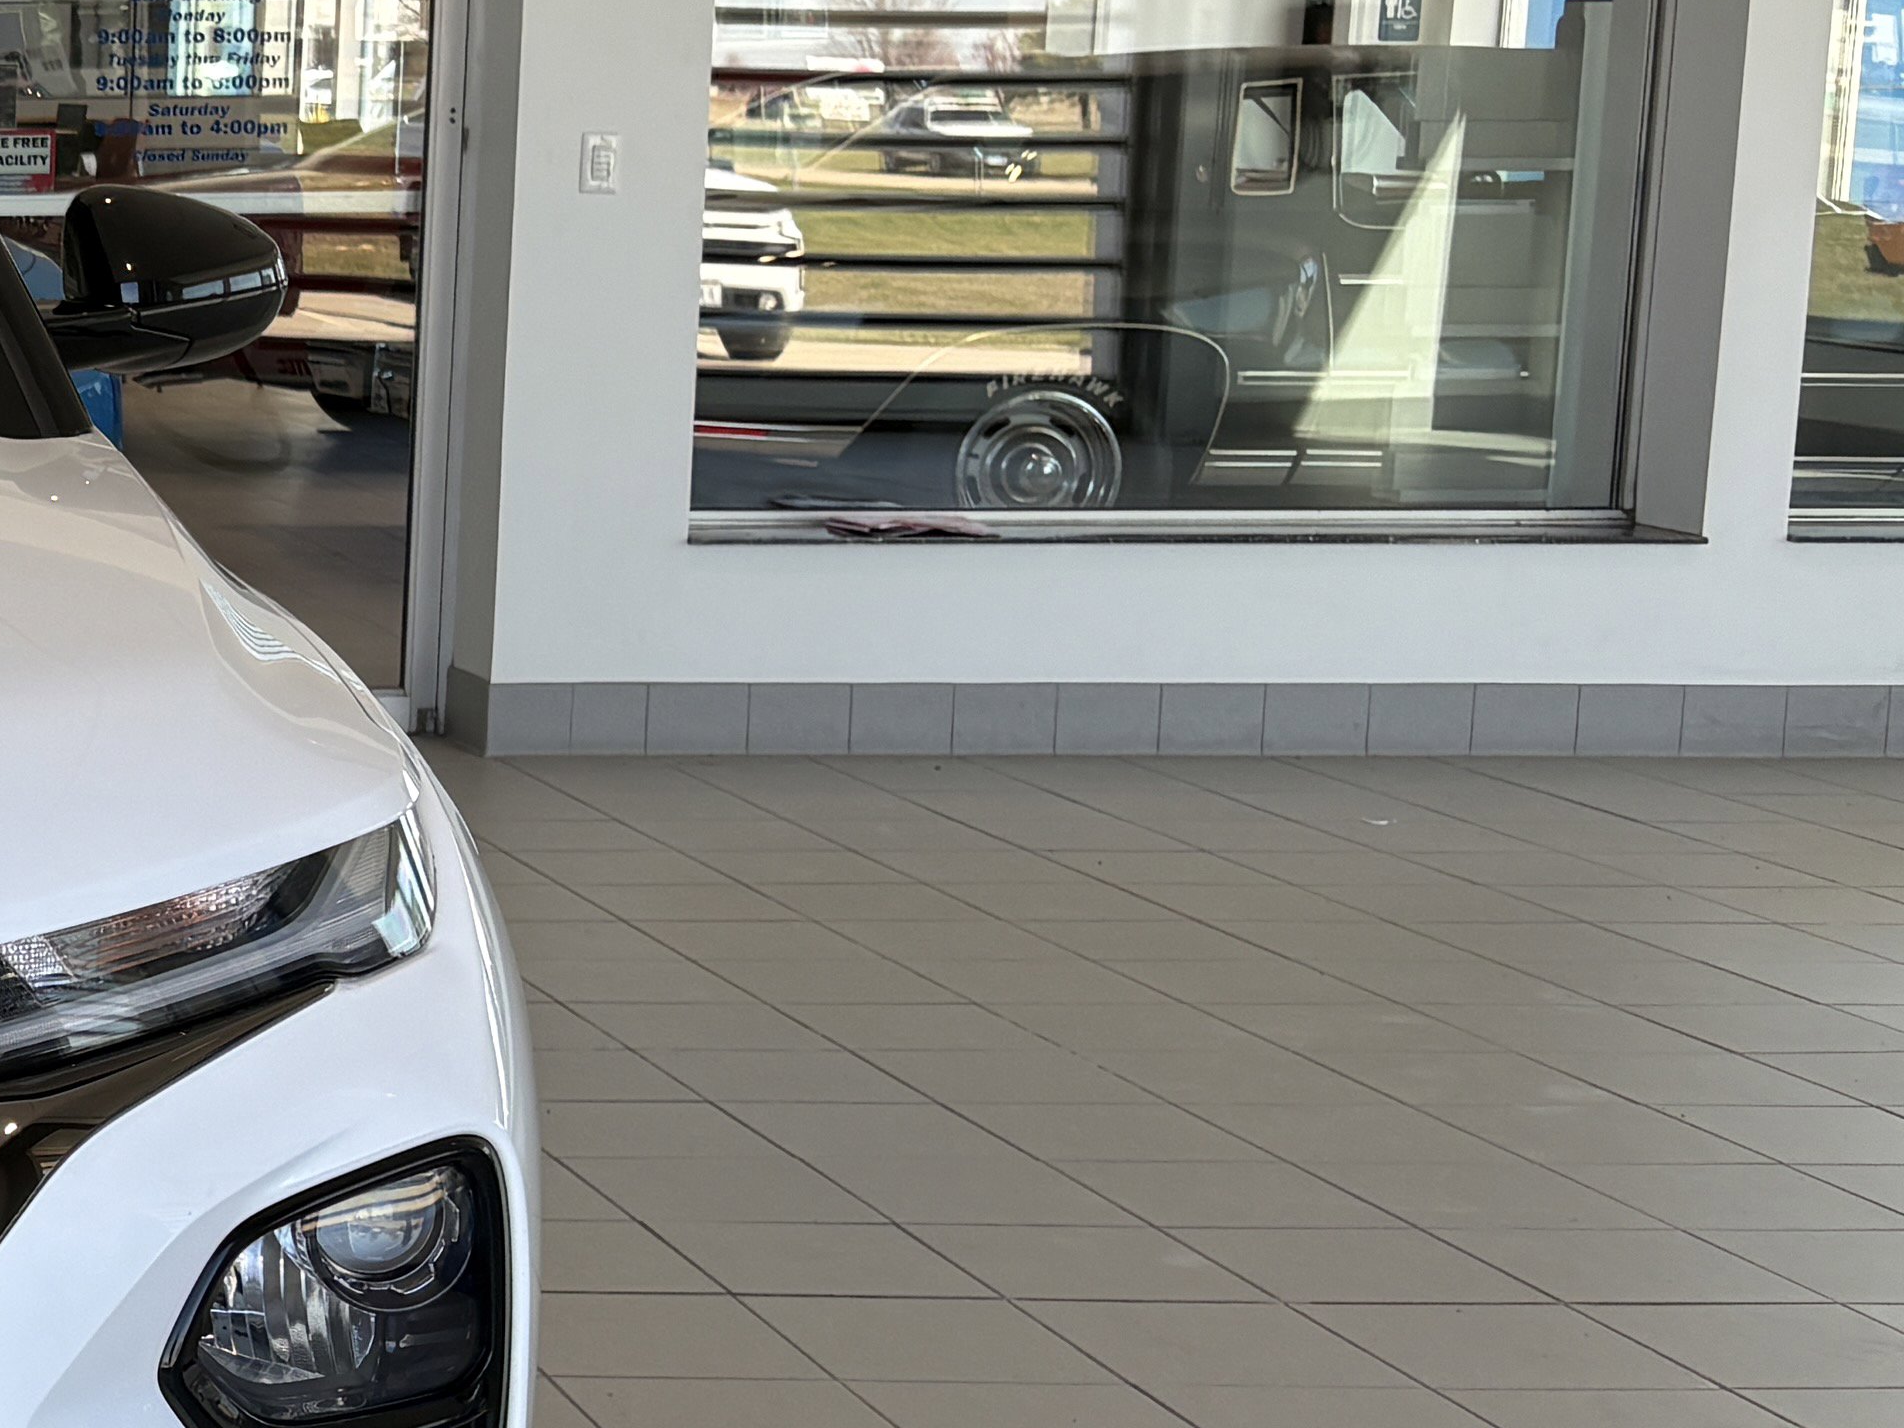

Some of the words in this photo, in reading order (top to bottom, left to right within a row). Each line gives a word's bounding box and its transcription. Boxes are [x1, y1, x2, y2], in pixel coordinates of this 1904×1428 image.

[159, 9, 225, 23] onday
[185, 30, 205, 43] to
[213, 28, 291, 45] 8:00pm
[227, 52, 281, 68] Friday
[96, 75, 174, 91] 9:00am
[183, 76, 202, 90] to
[148, 103, 230, 118] Saturday
[181, 121, 201, 135] to
[210, 119, 288, 137] 4:00pm
[13, 137, 49, 149] FREE
[192, 148, 249, 163] Sunday
